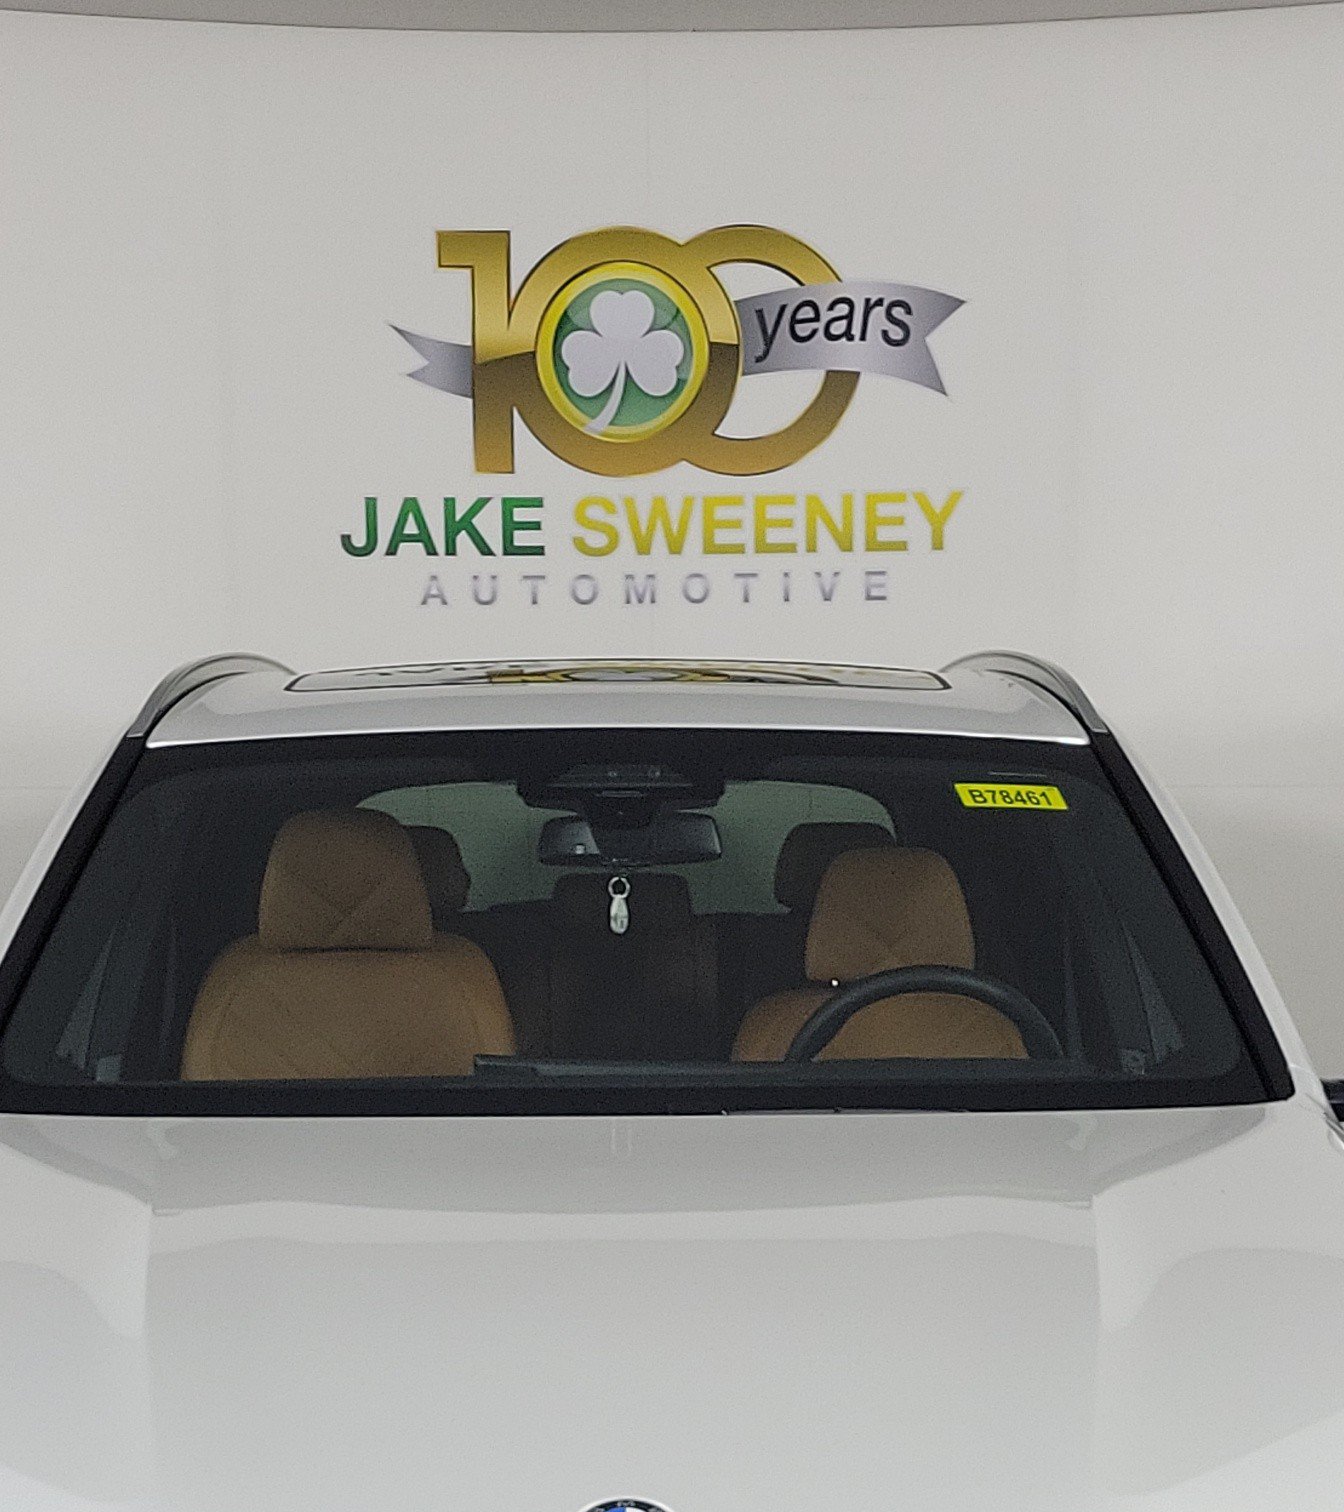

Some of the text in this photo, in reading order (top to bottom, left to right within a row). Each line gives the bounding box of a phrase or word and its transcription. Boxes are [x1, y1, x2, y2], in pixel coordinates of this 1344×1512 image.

[435, 223, 914, 477] 100 years
[340, 491, 964, 558] JAKE SWEENEY
[421, 570, 888, 606] AUTOMOTIVE
[968, 788, 1053, 806] B78461
